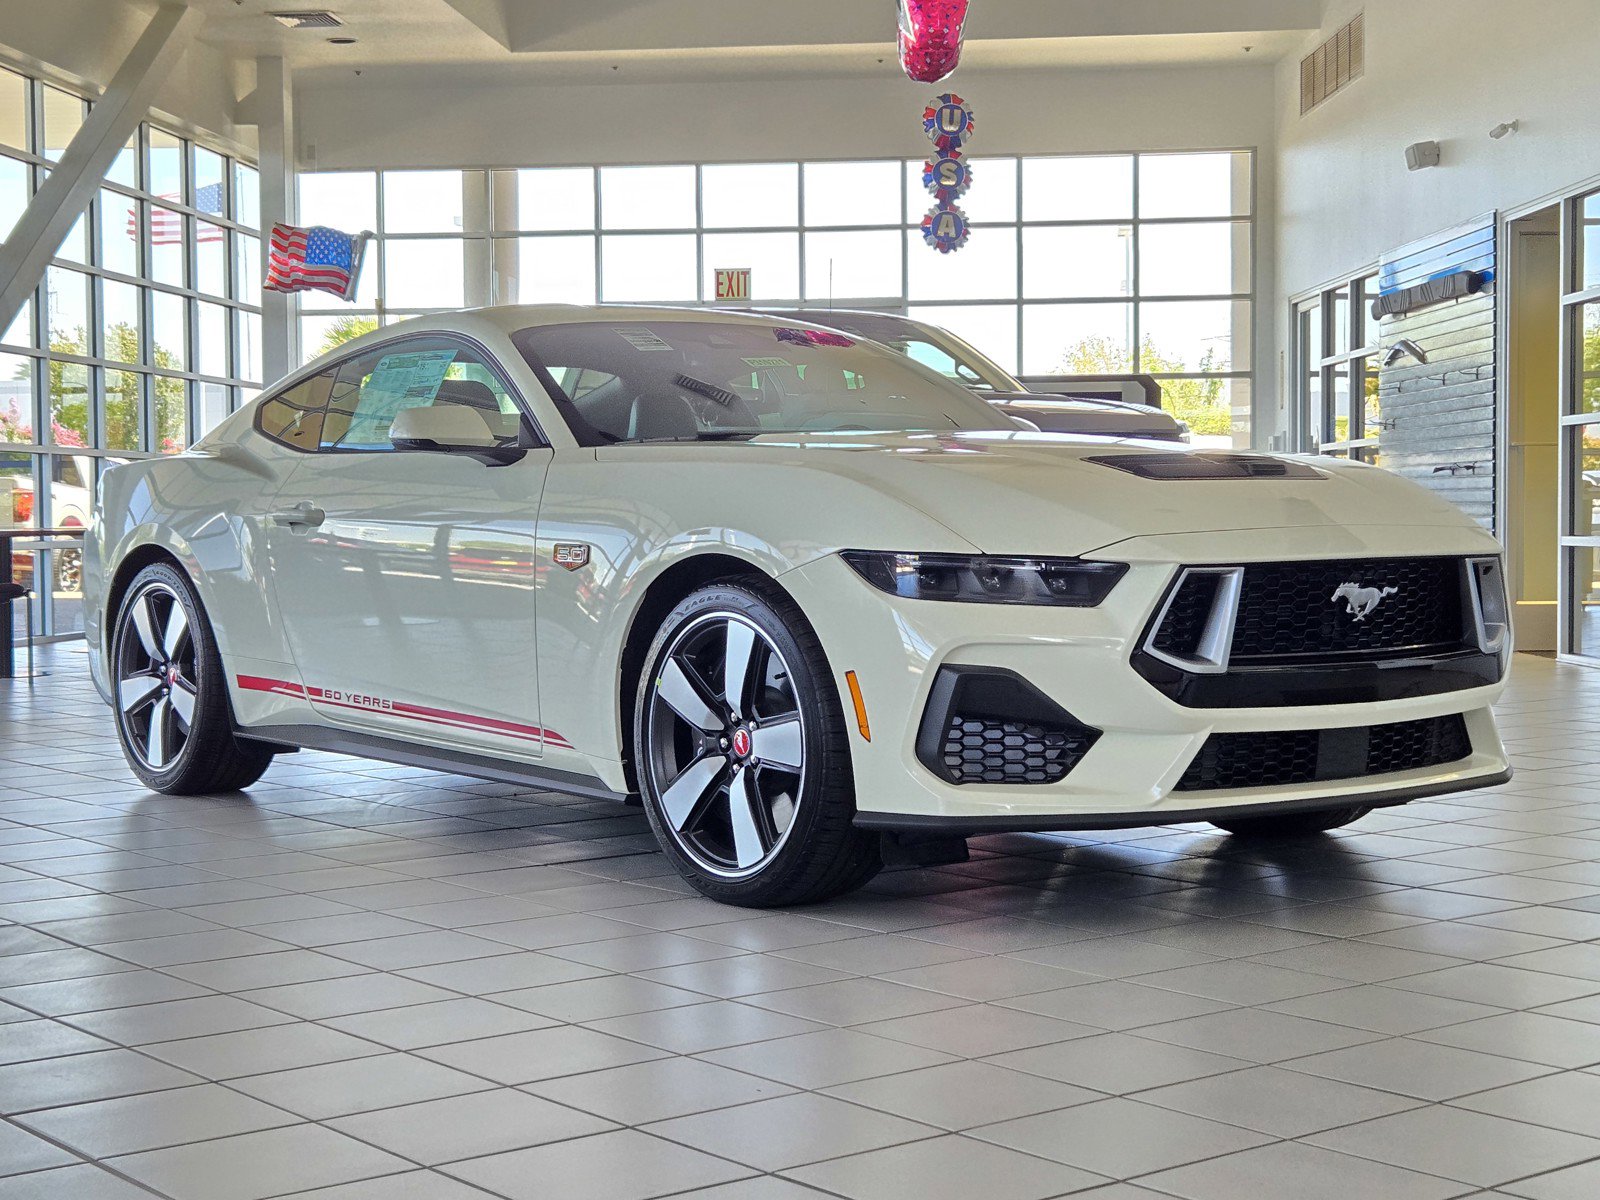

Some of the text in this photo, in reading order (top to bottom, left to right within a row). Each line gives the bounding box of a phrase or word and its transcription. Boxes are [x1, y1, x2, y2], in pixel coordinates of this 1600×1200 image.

[716, 271, 750, 298] EXIT
[556, 547, 584, 563] 5.0
[684, 593, 722, 611] EAGLE
[324, 689, 391, 709] 60 YEARS
